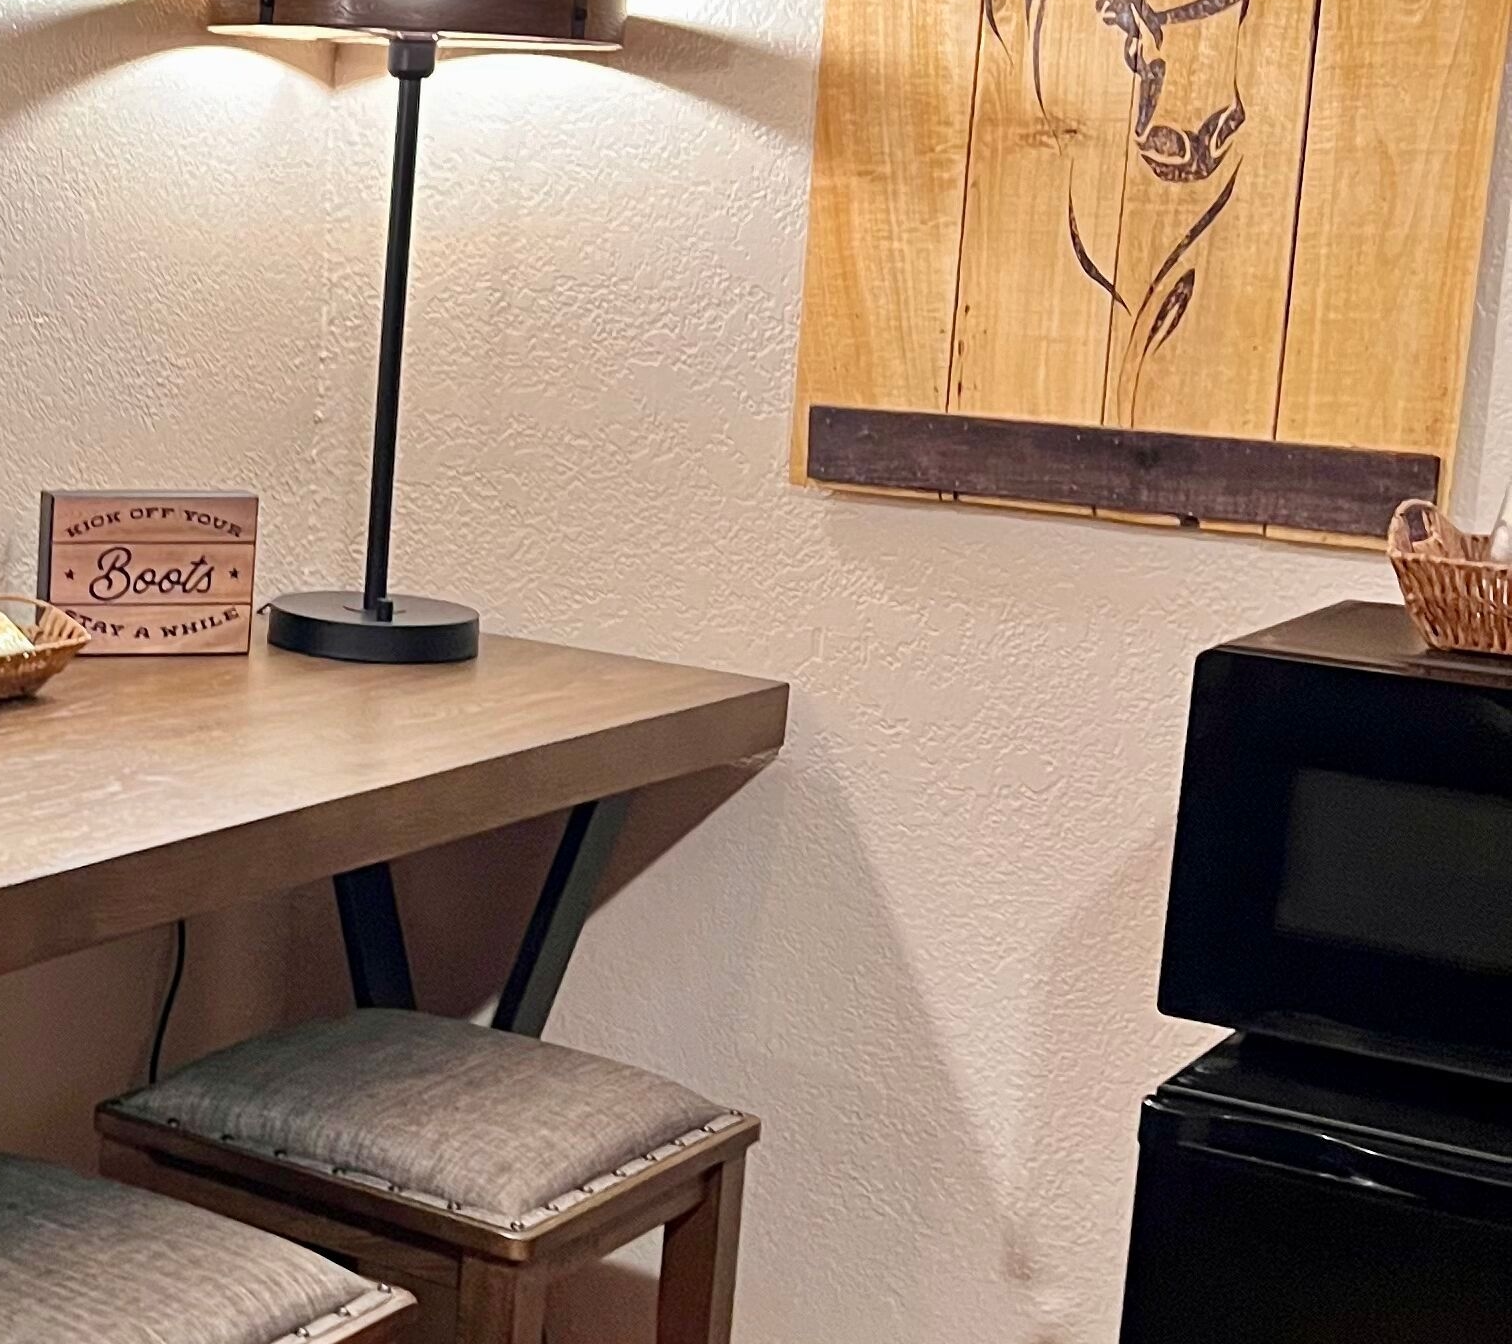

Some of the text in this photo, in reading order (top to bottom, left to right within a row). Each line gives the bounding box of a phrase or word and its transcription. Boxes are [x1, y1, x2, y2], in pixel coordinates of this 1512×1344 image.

[130, 507, 175, 521] OFF
[184, 510, 243, 537] YOUR
[88, 546, 215, 601] Boots
[134, 627, 150, 639] A
[160, 608, 239, 638] WHILE
